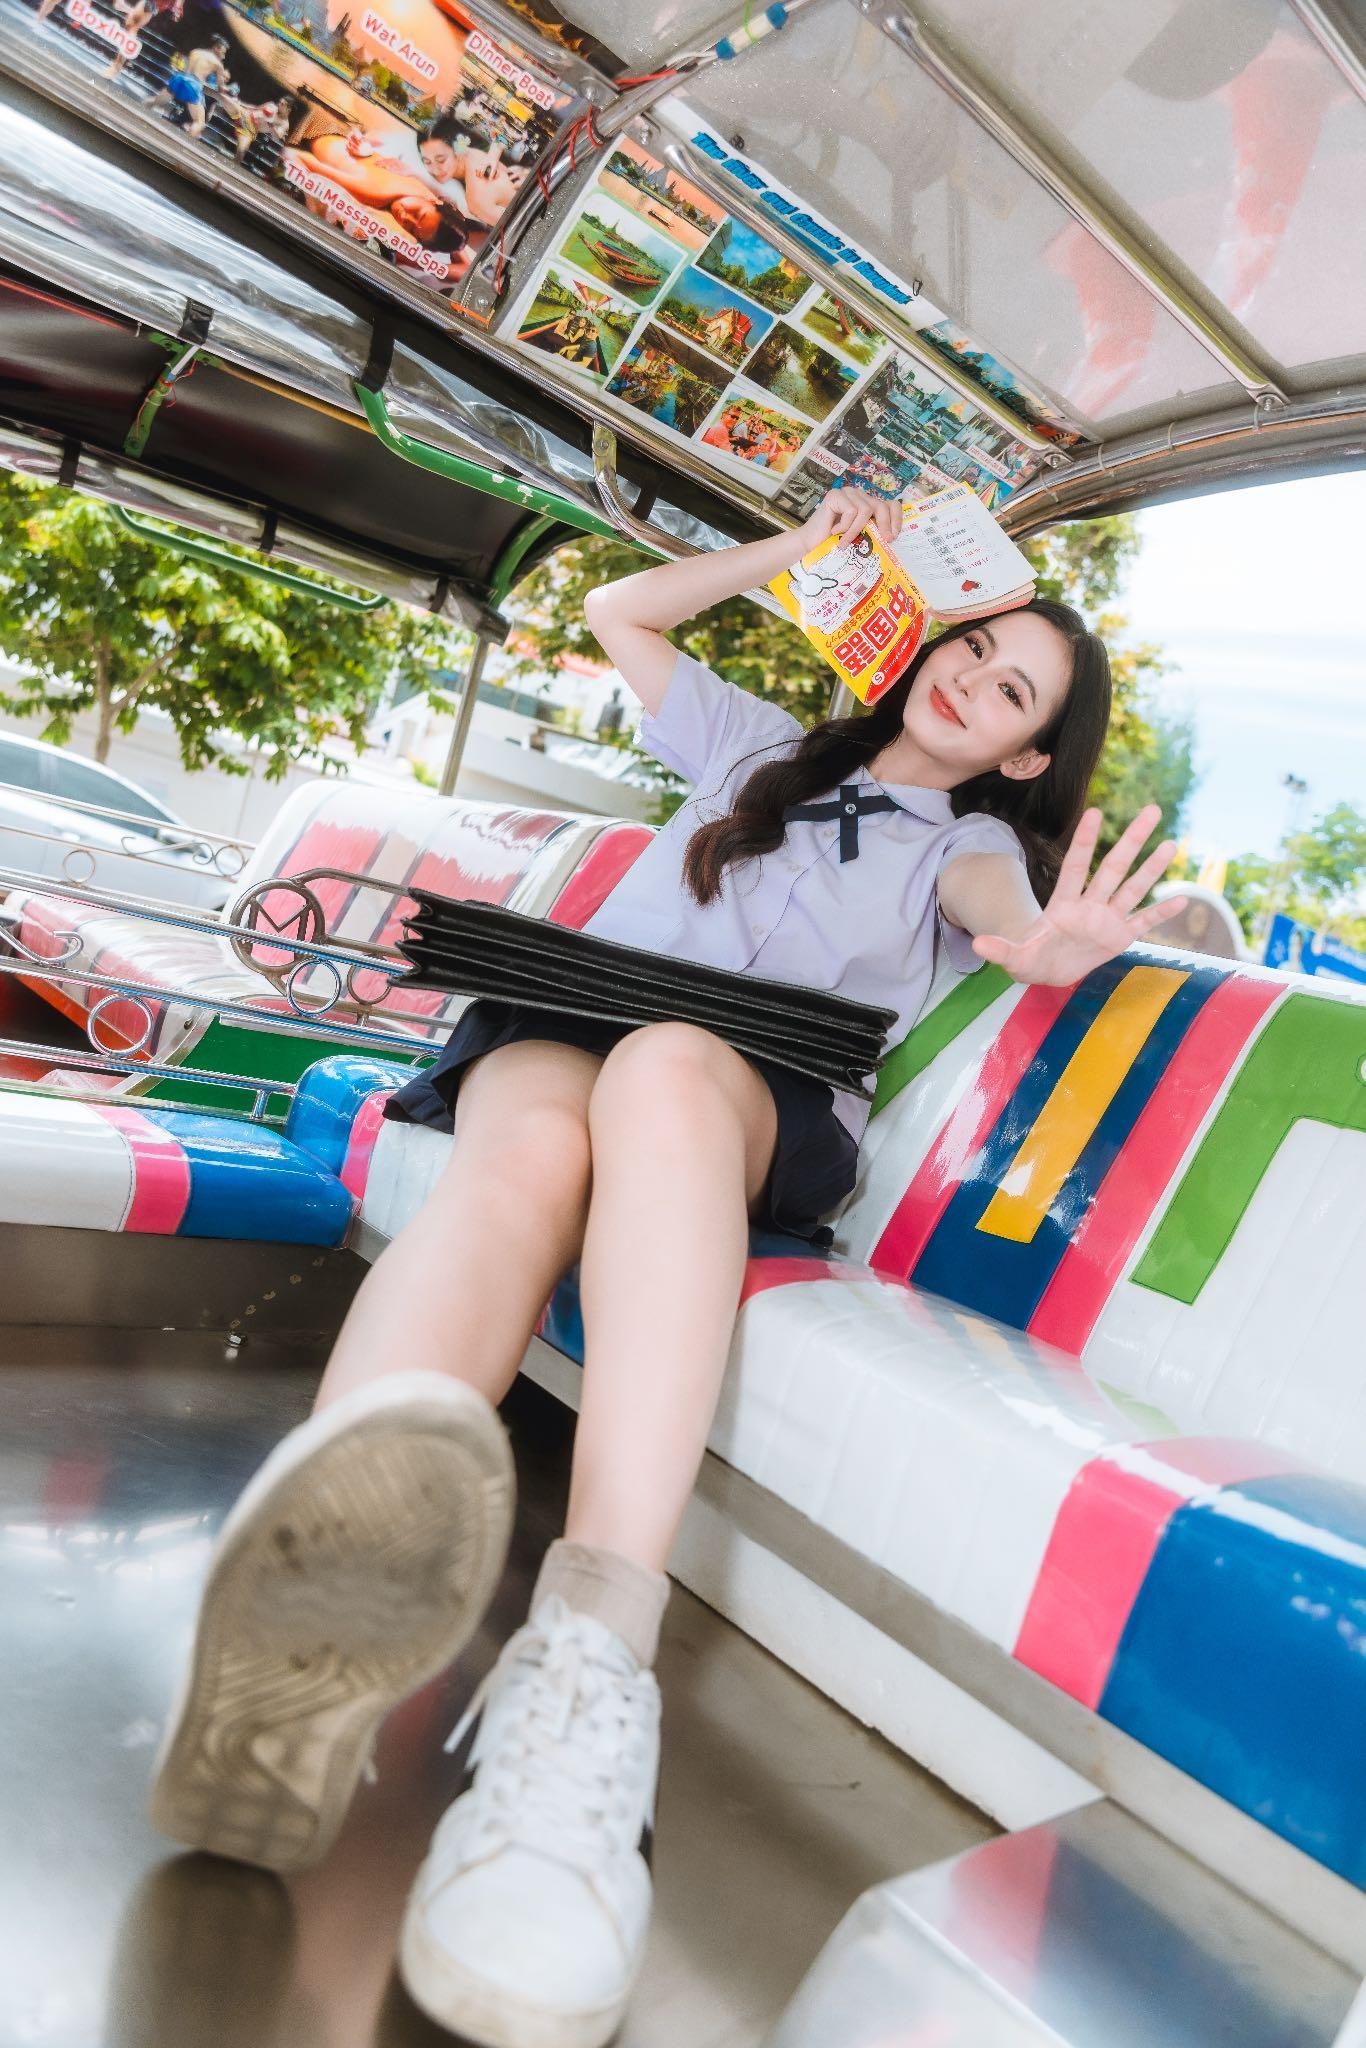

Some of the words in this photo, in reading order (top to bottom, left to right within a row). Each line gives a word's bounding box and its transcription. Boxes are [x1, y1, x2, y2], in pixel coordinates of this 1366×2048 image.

[70, 1, 139, 55] Boxing
[364, 14, 397, 46] Wat
[400, 43, 436, 77] Arun
[469, 34, 516, 78] Dinner
[518, 75, 553, 107] Boat
[288, 163, 319, 193] Thai
[324, 189, 387, 238] Massage
[391, 235, 419, 258] and
[421, 253, 448, 276] Spa
[691, 132, 728, 159] The
[721, 158, 768, 190] River
[760, 190, 800, 215] and
[790, 213, 845, 250] Canals
[837, 248, 861, 263] in
[852, 261, 914, 304] Bangkok
[809, 449, 844, 472] BANGKOK
[832, 584, 908, 678] 中国語
